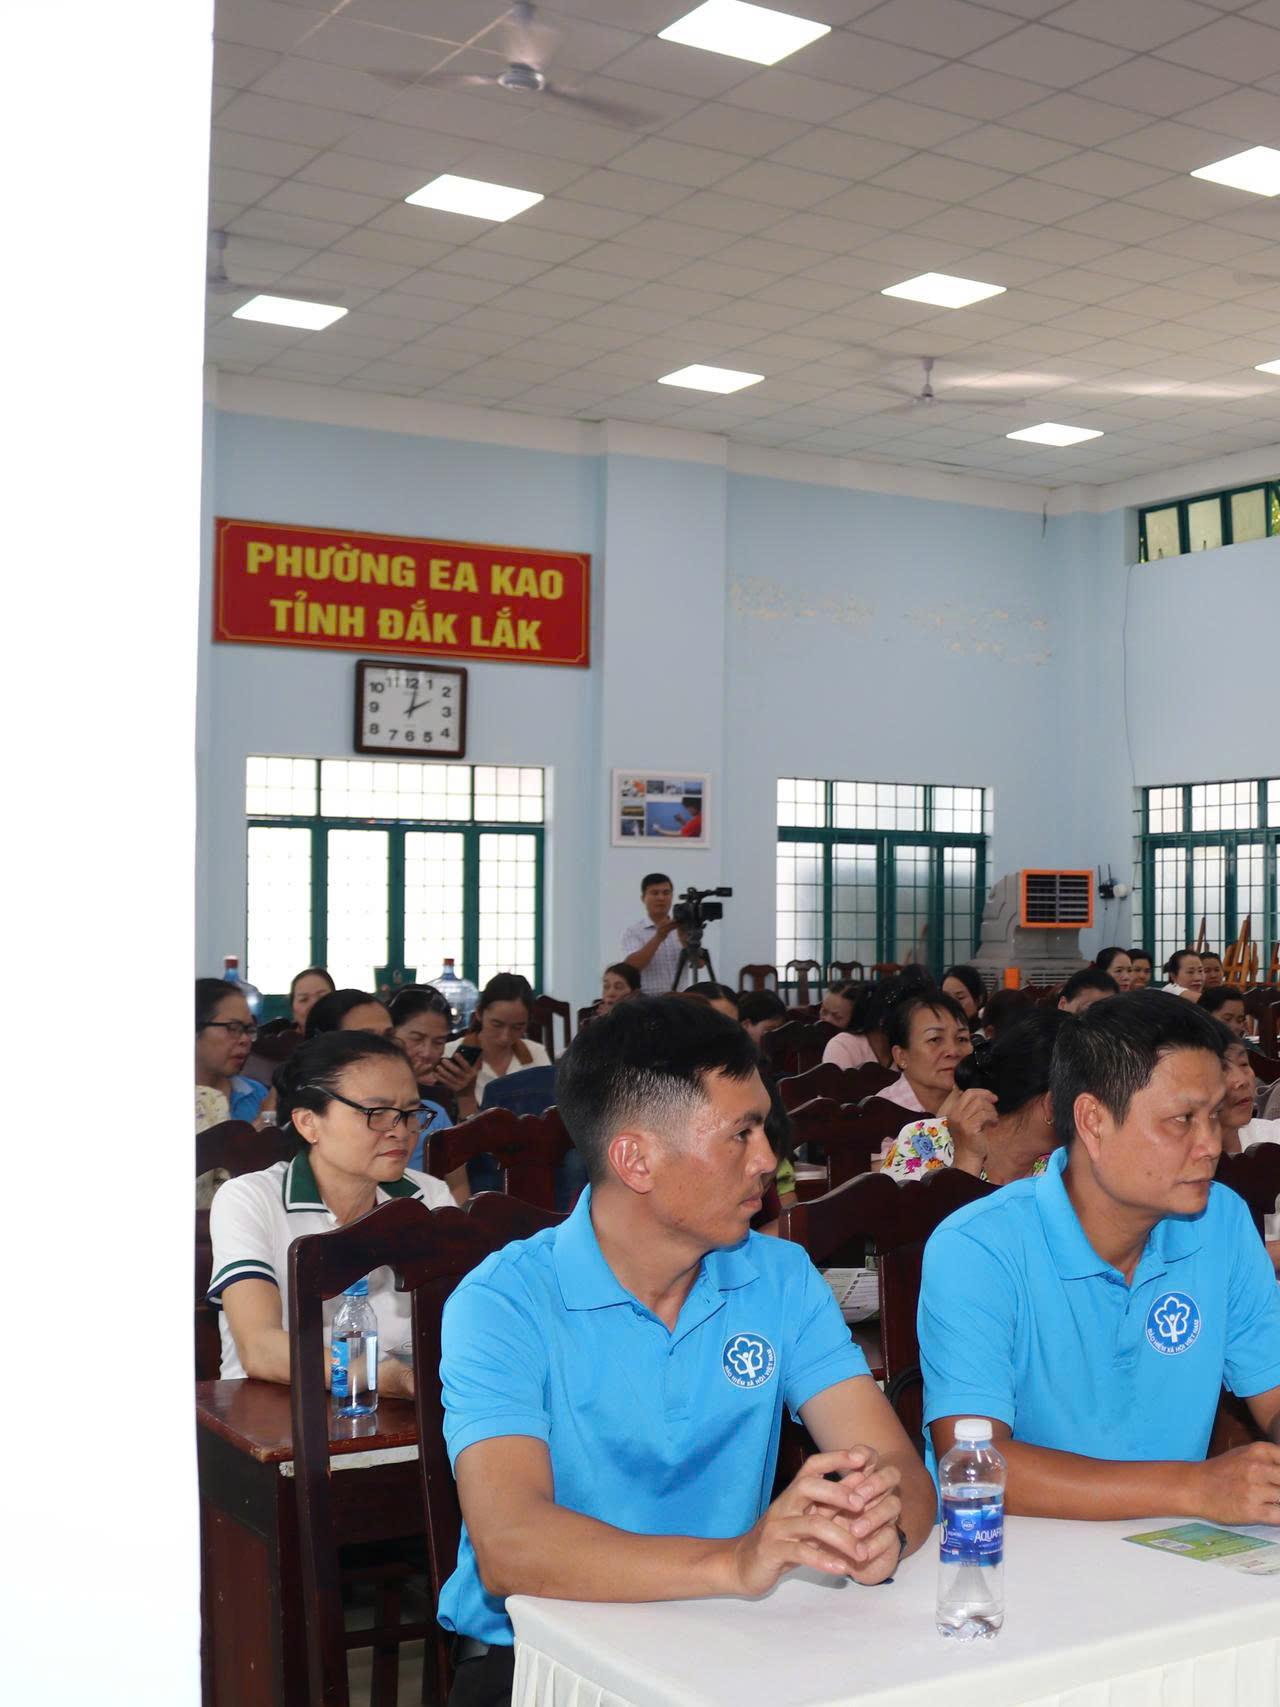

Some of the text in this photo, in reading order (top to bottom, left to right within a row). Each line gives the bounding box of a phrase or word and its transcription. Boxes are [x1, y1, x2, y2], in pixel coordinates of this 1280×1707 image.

[246, 541, 565, 600] PHƯỜNG EA KAO
[270, 590, 542, 651] TỈNH ĐẮK LẮK
[370, 681, 385, 694] 10
[386, 676, 399, 688] 11
[405, 678, 419, 689] 12
[426, 679, 433, 690] 1
[442, 686, 451, 698] 2
[369, 701, 380, 713] 9
[441, 706, 452, 718] 3
[369, 723, 379, 735] 8
[388, 729, 398, 740] 7
[440, 728, 450, 738] 4
[405, 730, 415, 742] 6
[423, 731, 433, 743] 5
